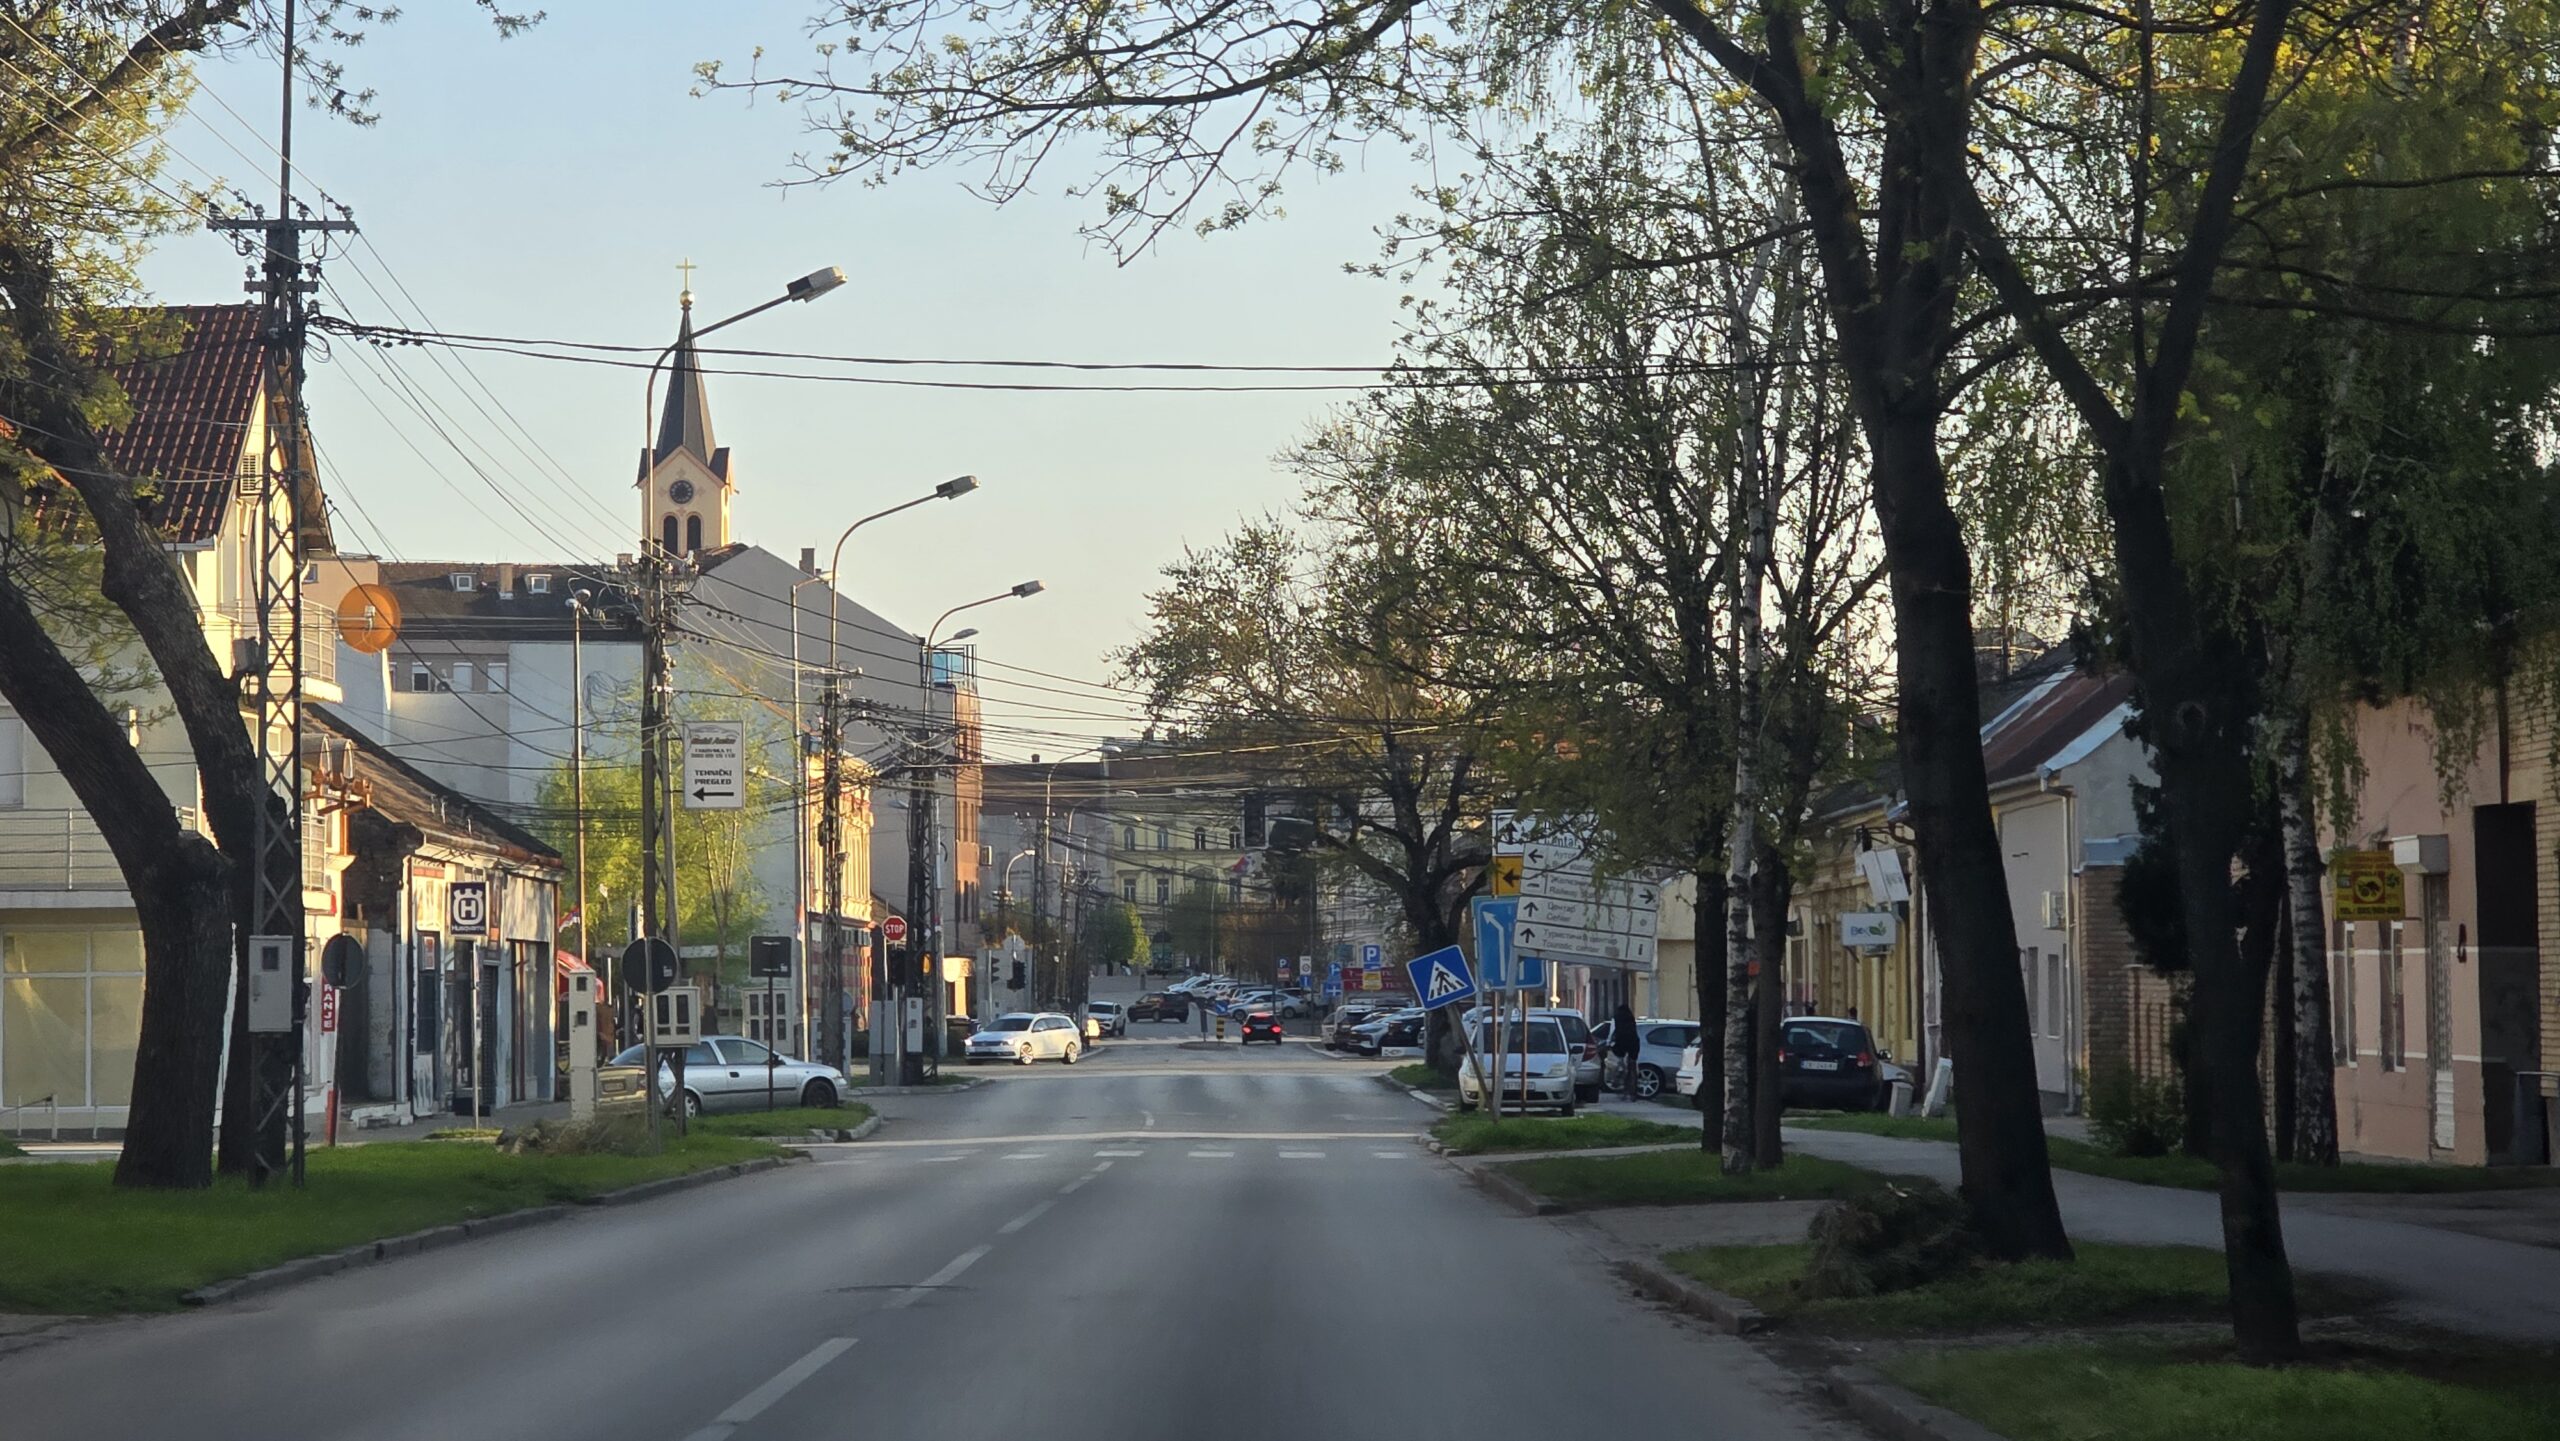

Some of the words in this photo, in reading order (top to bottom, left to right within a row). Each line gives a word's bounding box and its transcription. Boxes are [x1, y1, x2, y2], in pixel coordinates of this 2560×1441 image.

[461, 900, 476, 918] H
[885, 924, 904, 934] STOP
[1367, 947, 1377, 961] P
